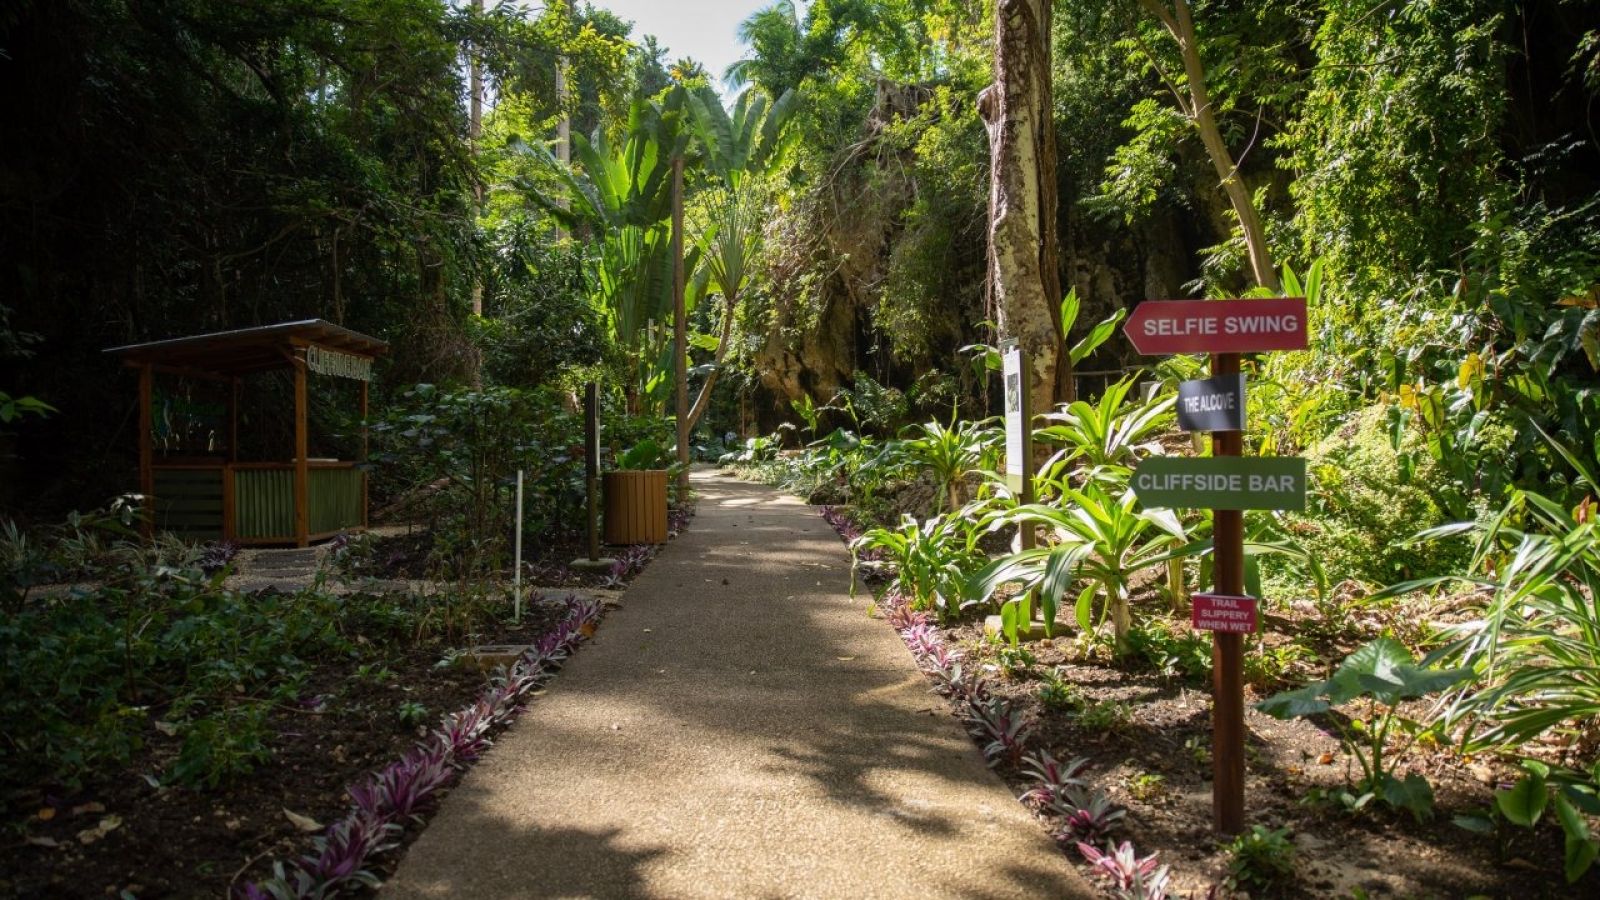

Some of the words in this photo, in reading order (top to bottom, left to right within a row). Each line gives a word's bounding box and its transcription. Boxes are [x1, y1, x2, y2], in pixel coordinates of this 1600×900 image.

[1144, 318, 1217, 336] SELFIE
[1224, 315, 1298, 334] SWING
[1184, 397, 1199, 413] THE
[1200, 392, 1235, 412] ALCOVE
[1138, 474, 1242, 491] CLIFFSIDE
[1249, 475, 1295, 492] BAR
[1211, 599, 1239, 608] TRAIL
[1201, 609, 1249, 620] SLIPPERY
[1198, 620, 1228, 630] WHEN
[1230, 622, 1252, 631] WET
